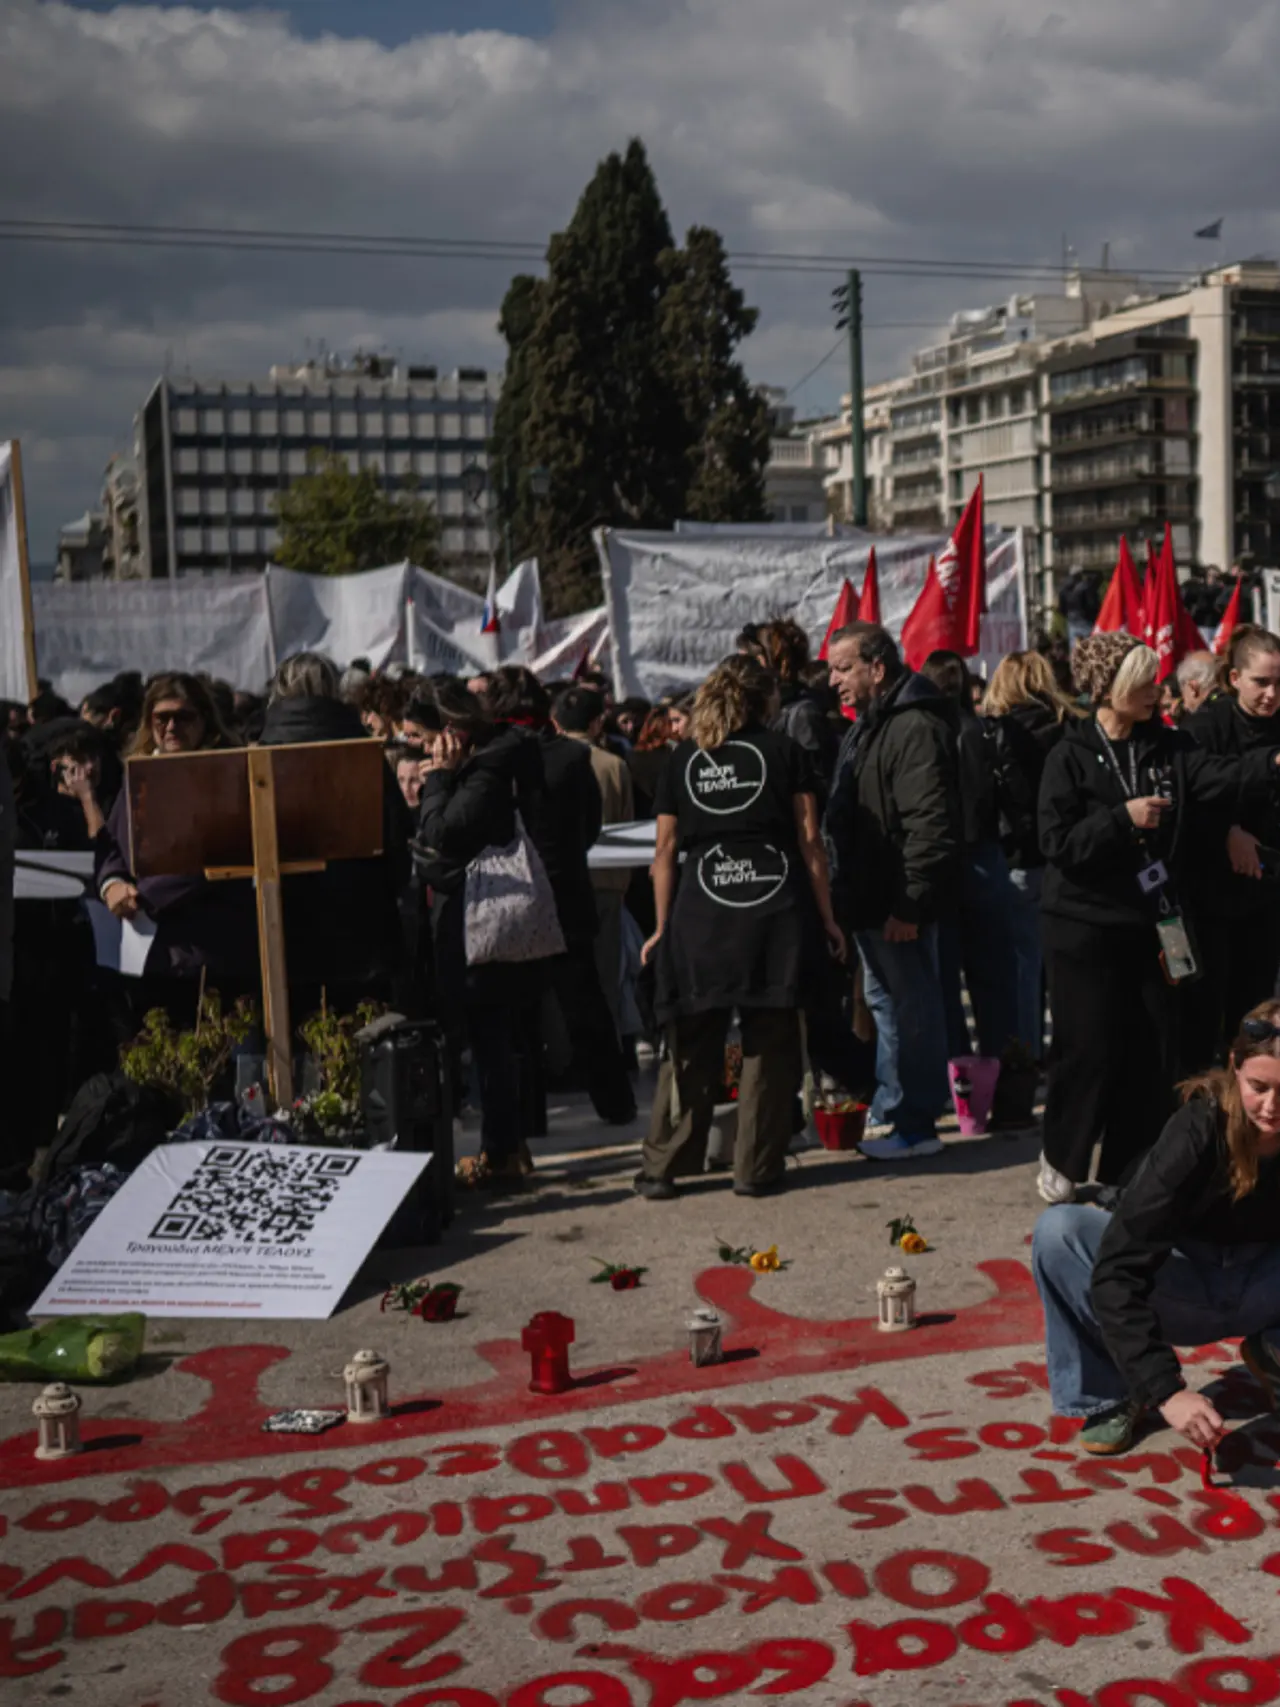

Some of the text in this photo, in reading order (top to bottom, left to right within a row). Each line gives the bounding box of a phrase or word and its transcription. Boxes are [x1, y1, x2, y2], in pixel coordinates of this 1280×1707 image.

[699, 764, 735, 780] ΜΕΧΡΙ
[696, 777, 738, 794] ΤΕΛΟΥΣ
[714, 859, 753, 876] ΜΕΧΡΙ
[712, 870, 757, 887] ΤΕΛΟΥΣ
[211, 1607, 466, 1707] 28
